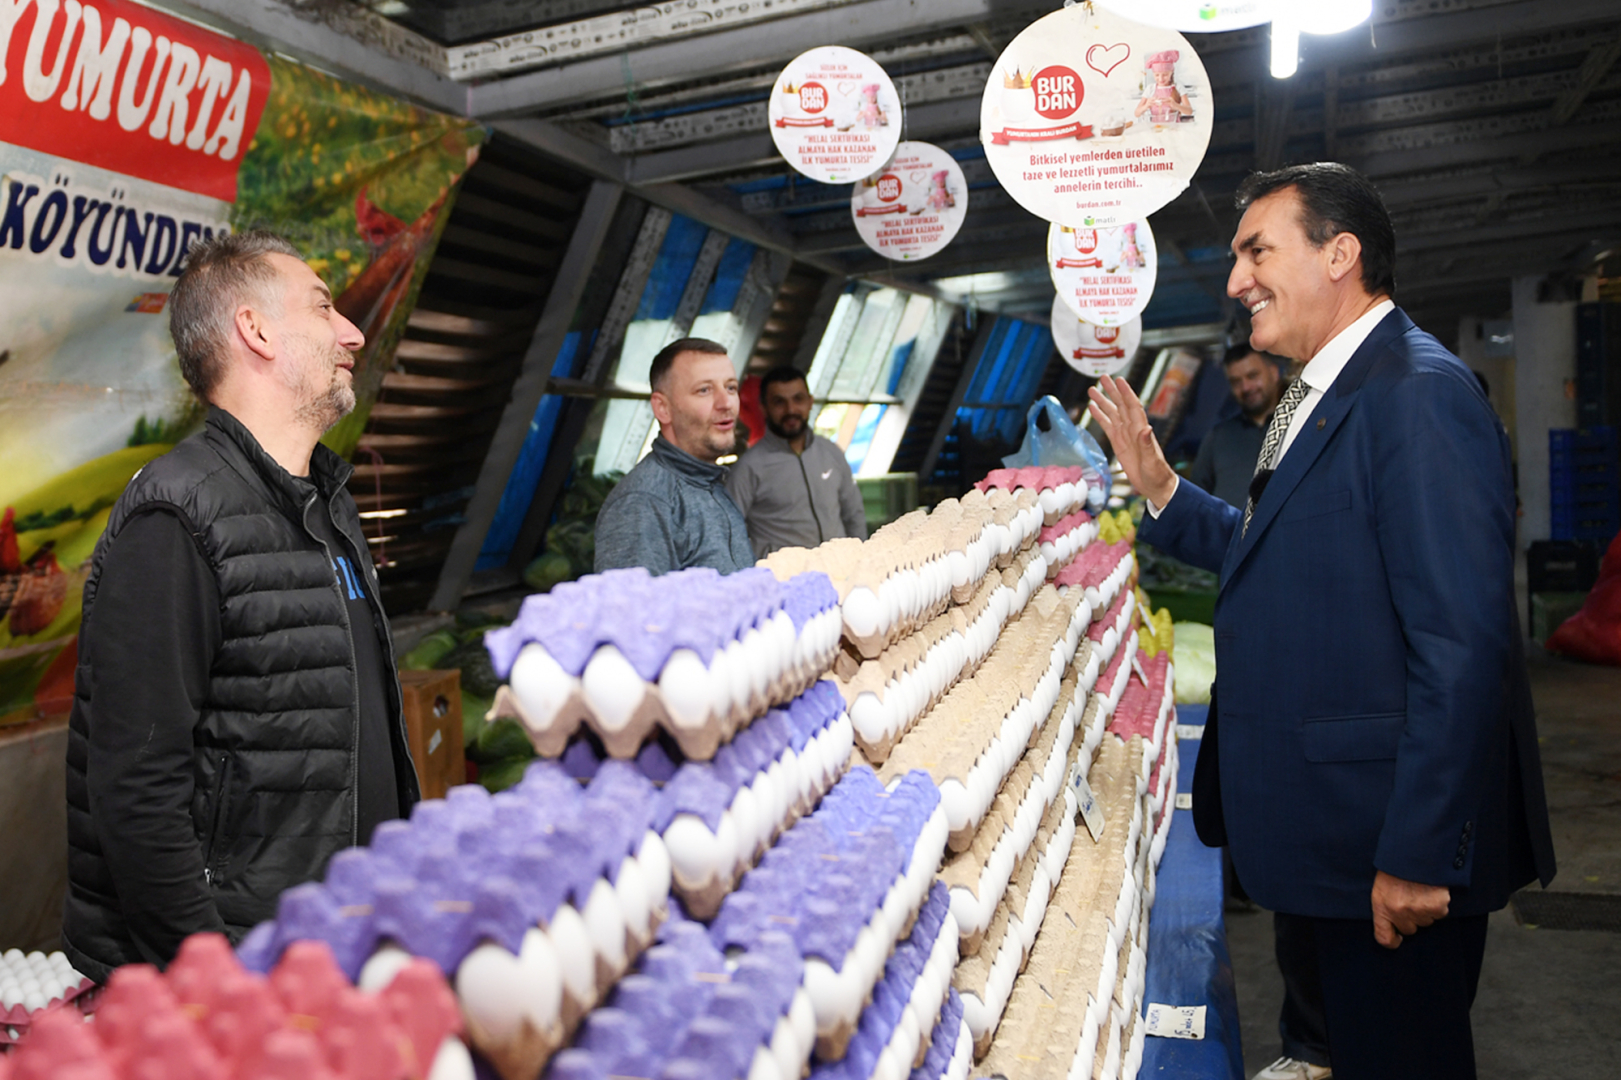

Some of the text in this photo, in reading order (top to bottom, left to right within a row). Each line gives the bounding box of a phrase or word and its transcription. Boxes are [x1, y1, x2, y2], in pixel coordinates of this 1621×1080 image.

[0, 0, 251, 160] YUMURTA
[1037, 75, 1075, 94] BUR
[801, 87, 824, 98] BUR
[802, 98, 824, 108] DAN
[1038, 92, 1076, 111] DAN
[798, 144, 876, 154] ALMAYA HAK KAZANAN
[802, 155, 813, 164] İLK
[815, 155, 848, 164] YUMURTA
[1030, 146, 1165, 166] Bitkisel yemlerden üretilen
[1023, 162, 1174, 181] taze ve lezzetli yumurtalarımız
[878, 178, 898, 188] BUR
[1054, 177, 1143, 193] annelerin tercihi..
[880, 188, 899, 198] DAN
[1076, 200, 1122, 209] burdan.com.tr
[876, 224, 944, 238] ALMAYA HAK KAZANAN
[891, 236, 919, 245] YUMURTA
[1076, 238, 1095, 248] DAN
[1075, 286, 1138, 296] ALMAYA HAK KAZANAN
[1090, 298, 1116, 307] YUMURTA
[1096, 327, 1116, 338] DAN
